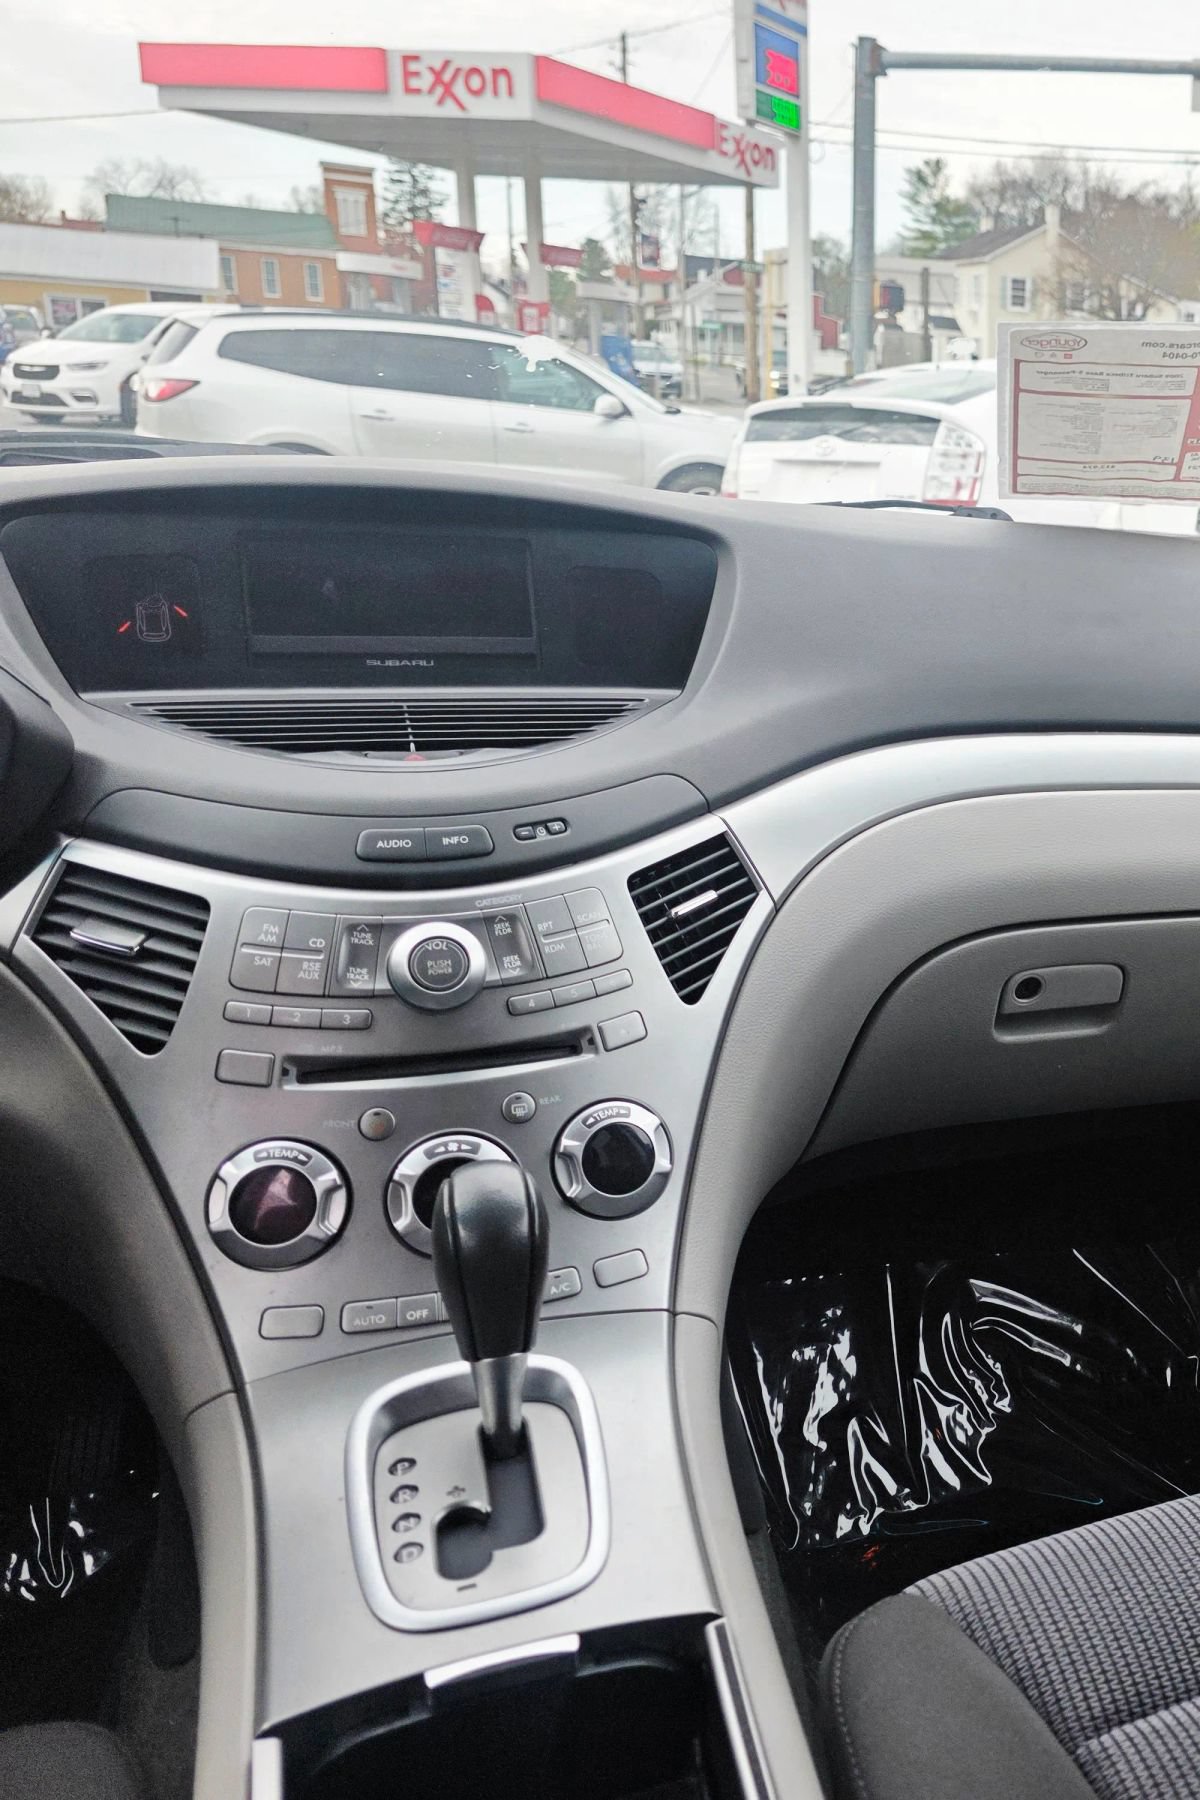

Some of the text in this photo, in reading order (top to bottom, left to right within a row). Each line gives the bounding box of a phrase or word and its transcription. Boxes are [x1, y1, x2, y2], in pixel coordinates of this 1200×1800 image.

[402, 55, 513, 111] Exxon
[716, 123, 776, 177] Exxon
[366, 659, 434, 667] SUBARU
[376, 839, 412, 849] AUDIO
[442, 835, 469, 846] INFO
[475, 893, 522, 908] CATEGORY
[263, 923, 279, 934] FM
[494, 921, 511, 931] SEEK
[537, 921, 553, 932] RPT
[257, 932, 277, 943] AM
[353, 931, 373, 939] TUNE
[495, 927, 513, 937] FLDR
[309, 938, 326, 948] CD
[351, 937, 374, 946] TRACK
[425, 940, 449, 951] VOL
[545, 943, 566, 954] RDM
[254, 956, 274, 967] SAT
[427, 959, 452, 968] PUSH
[503, 954, 520, 963] SEEK
[302, 961, 322, 971] RSE
[349, 967, 369, 975] TUNE
[504, 961, 522, 970] FLDR
[297, 970, 320, 980] AUX
[347, 973, 370, 981] TRACK
[570, 989, 578, 998] 5
[528, 997, 536, 1008] 4
[293, 1012, 301, 1023] 2
[343, 1014, 351, 1025] 3
[593, 1107, 619, 1121] TEMP
[269, 1148, 299, 1160] TEMP
[550, 1282, 572, 1295] A/C
[353, 1313, 386, 1326] AUTO
[406, 1308, 429, 1321] OFF
